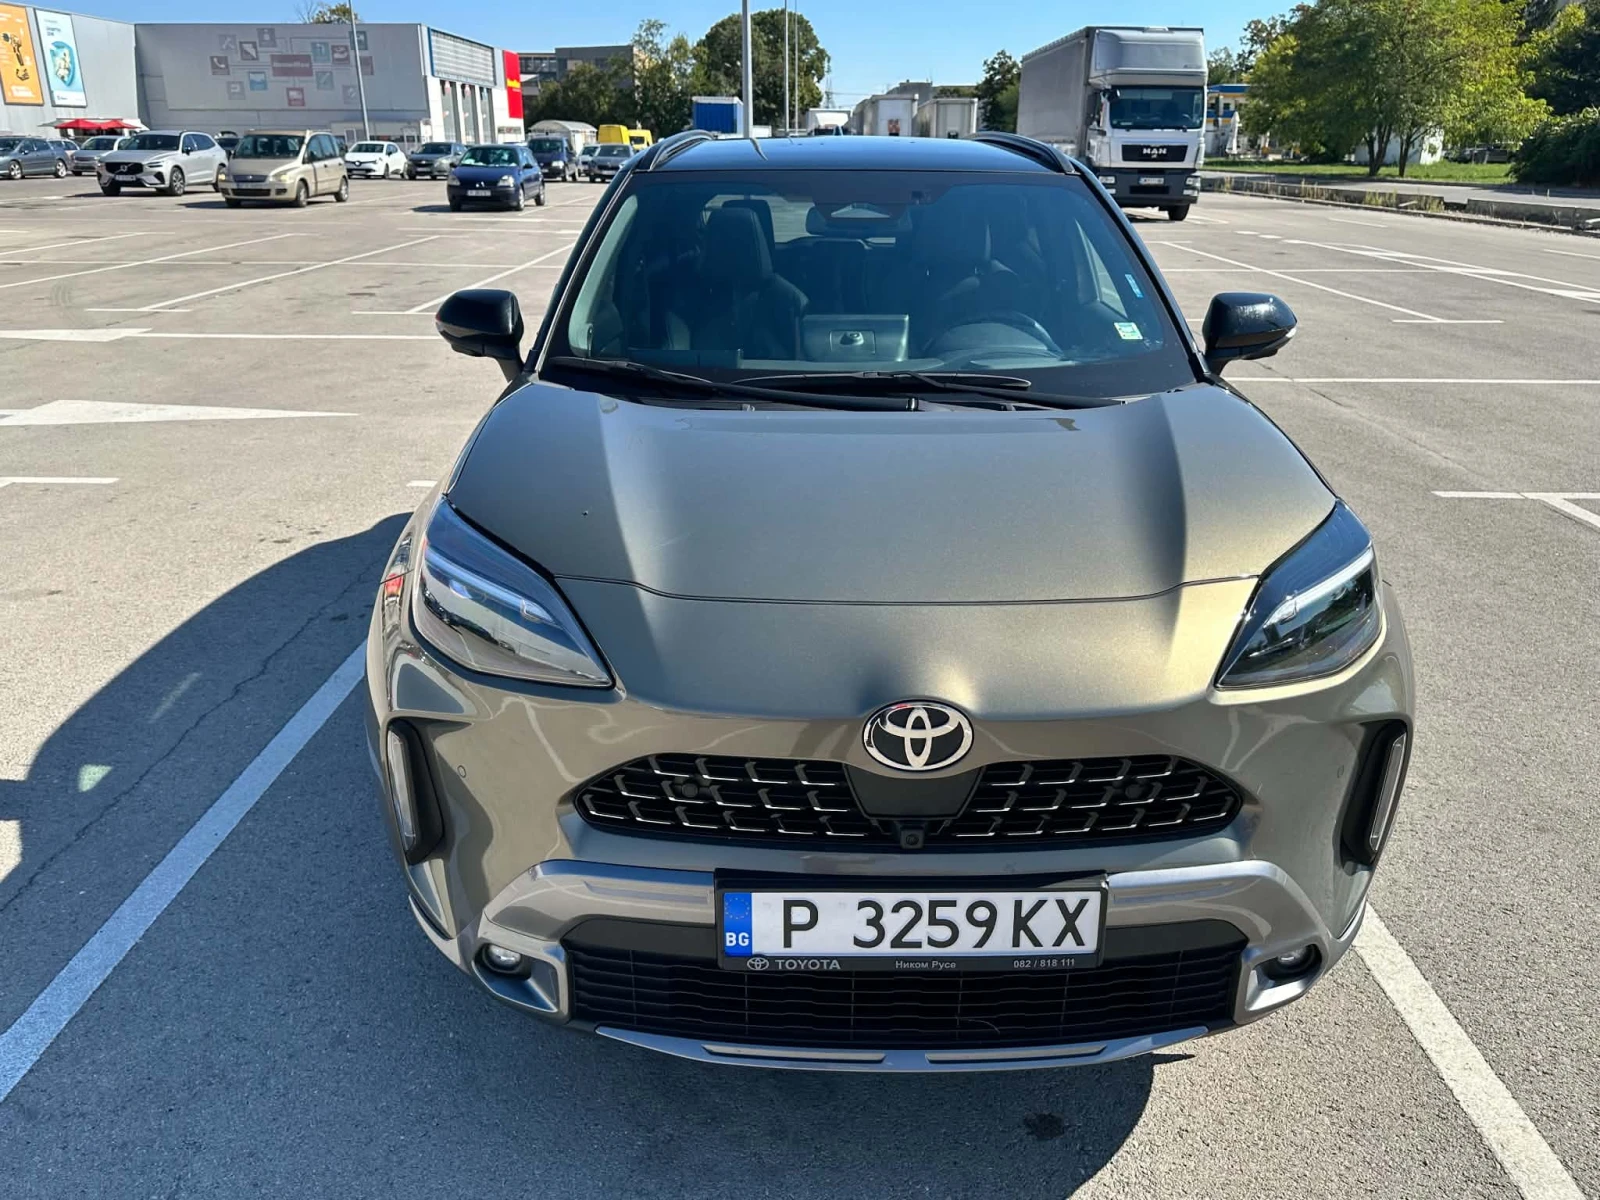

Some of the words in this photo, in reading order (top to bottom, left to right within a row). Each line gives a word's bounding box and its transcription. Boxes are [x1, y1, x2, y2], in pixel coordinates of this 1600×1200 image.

[783, 899, 819, 948] P
[852, 899, 999, 949] 3259
[1011, 898, 1090, 948] KX
[725, 932, 750, 947] BG
[775, 959, 841, 970] TOYOTA
[895, 960, 928, 969] Ником
[931, 960, 957, 971] Русе
[1013, 959, 1031, 968] 082
[1040, 959, 1058, 968] 818
[1060, 958, 1075, 968] 111
